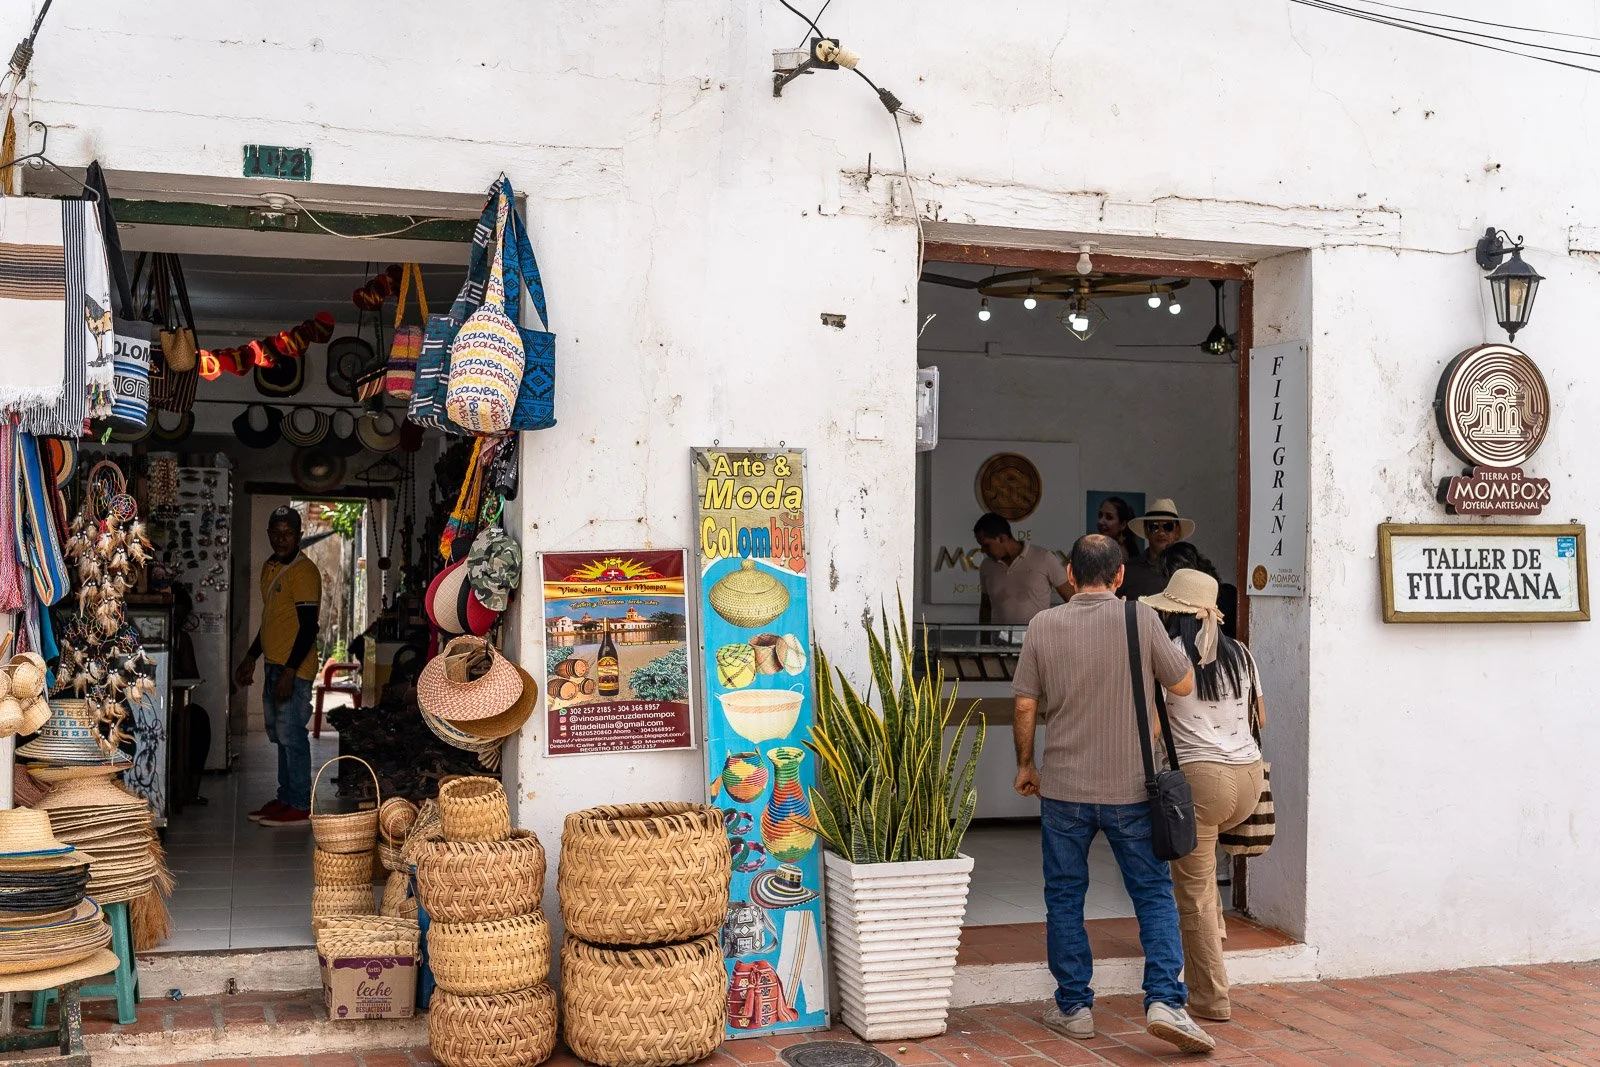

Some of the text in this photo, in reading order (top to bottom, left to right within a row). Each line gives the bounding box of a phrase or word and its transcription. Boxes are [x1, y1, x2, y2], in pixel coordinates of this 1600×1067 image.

[462, 332, 506, 347] COLOMBIA
[472, 340, 515, 361] COLOMBIA
[459, 358, 503, 373] COLOMBIA
[469, 367, 511, 388] COLOMBIA
[455, 386, 500, 399] COLOMBIA
[1270, 355, 1286, 557] FILIGRANA
[713, 455, 793, 477] Arte &
[1480, 472, 1522, 481] TIERRA DE
[702, 478, 804, 510] Moda
[1454, 482, 1550, 500] MOMPOX
[1462, 499, 1540, 510] JOYERÍA ARTESANAL
[702, 516, 804, 559] Colombia
[1422, 547, 1542, 570] TALLER DE
[1269, 574, 1301, 583] MOMPOX
[1406, 573, 1562, 600] FILIGRANA
[559, 587, 578, 596] Vino
[580, 584, 602, 595] Santa
[604, 584, 622, 594] Cruz
[633, 583, 667, 593] Mompox
[569, 712, 676, 723] @vinosantacruzdemompox
[570, 707, 582, 715] 302
[583, 706, 595, 714] 257
[570, 720, 664, 731] dittadeitalia@gmail.com
[356, 980, 393, 997] leche
